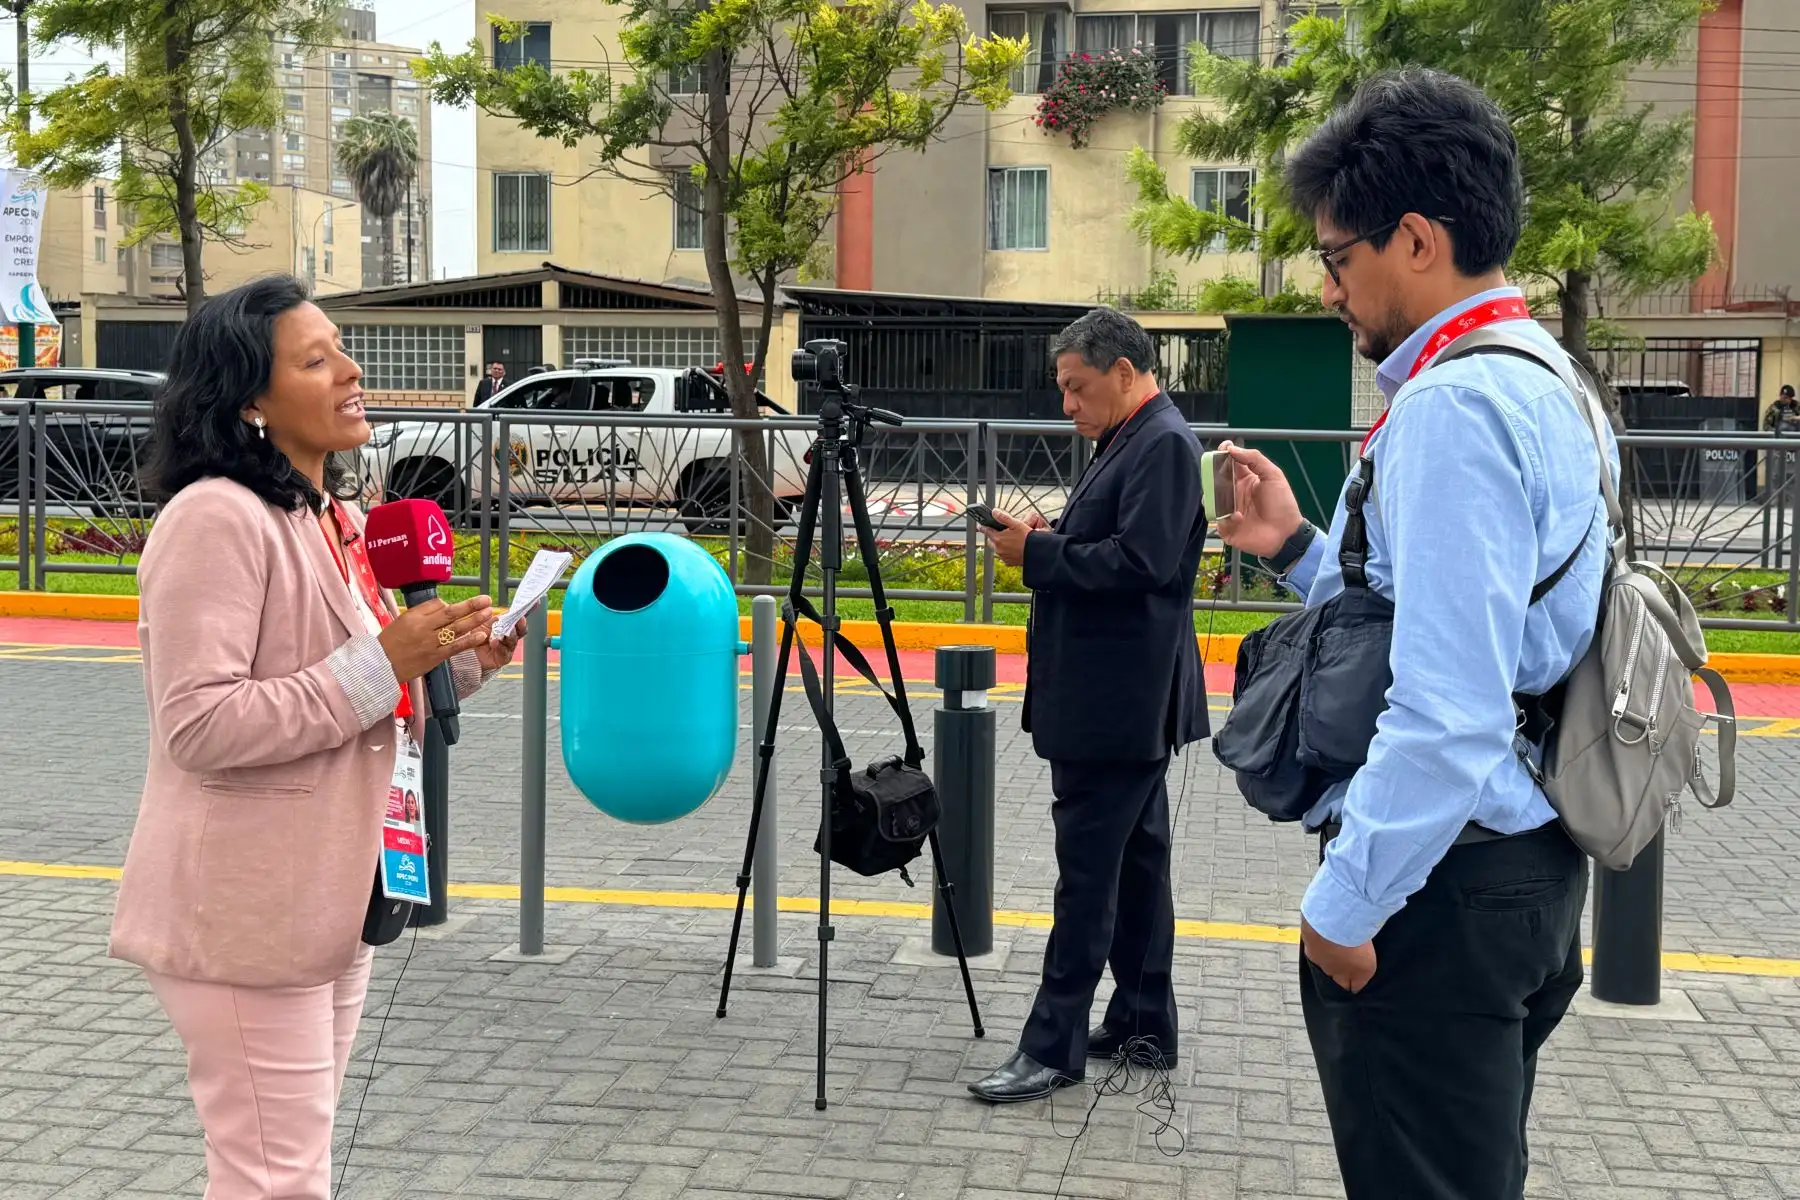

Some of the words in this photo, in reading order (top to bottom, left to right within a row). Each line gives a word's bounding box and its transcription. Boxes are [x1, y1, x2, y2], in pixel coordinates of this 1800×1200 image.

[3, 207, 30, 217] APEC
[536, 444, 639, 467] POLICÍA
[423, 553, 452, 565] andina
